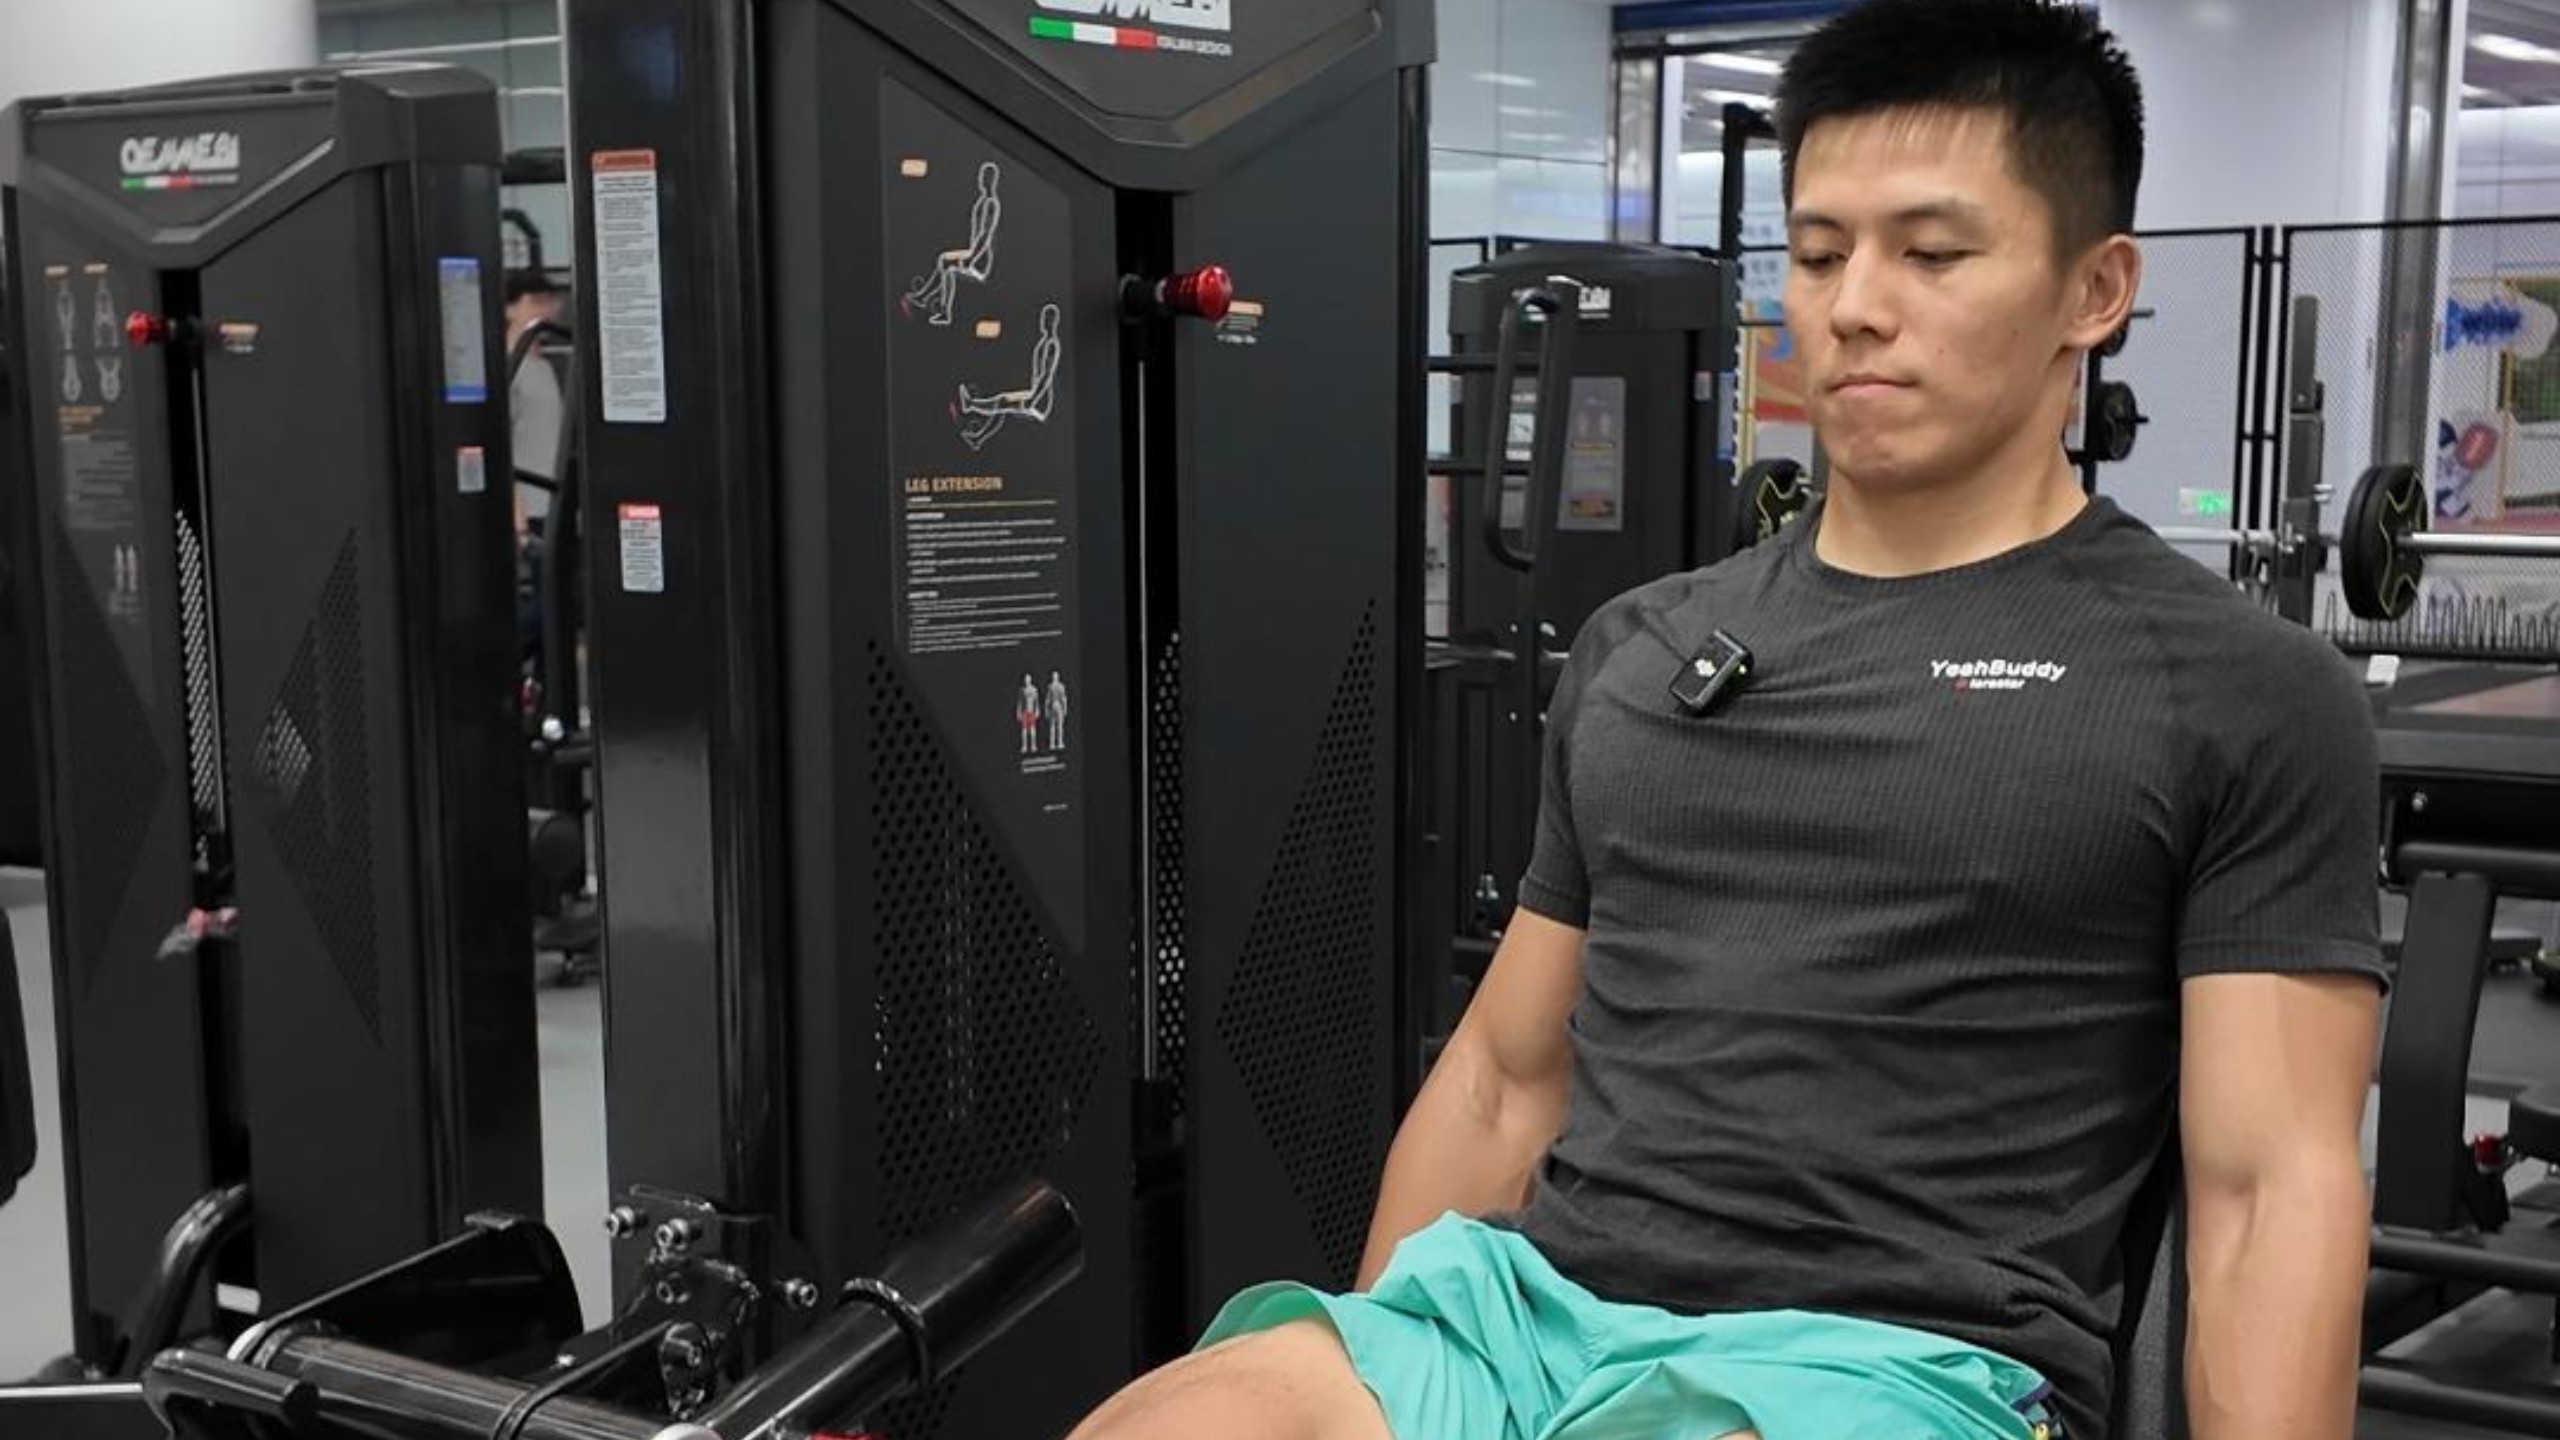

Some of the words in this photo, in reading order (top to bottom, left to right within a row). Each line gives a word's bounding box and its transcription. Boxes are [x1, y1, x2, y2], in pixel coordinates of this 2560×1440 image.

[905, 478, 931, 493] LEG
[933, 476, 1003, 493] EXTENSION
[1930, 659, 2067, 682] YeahBuddy
